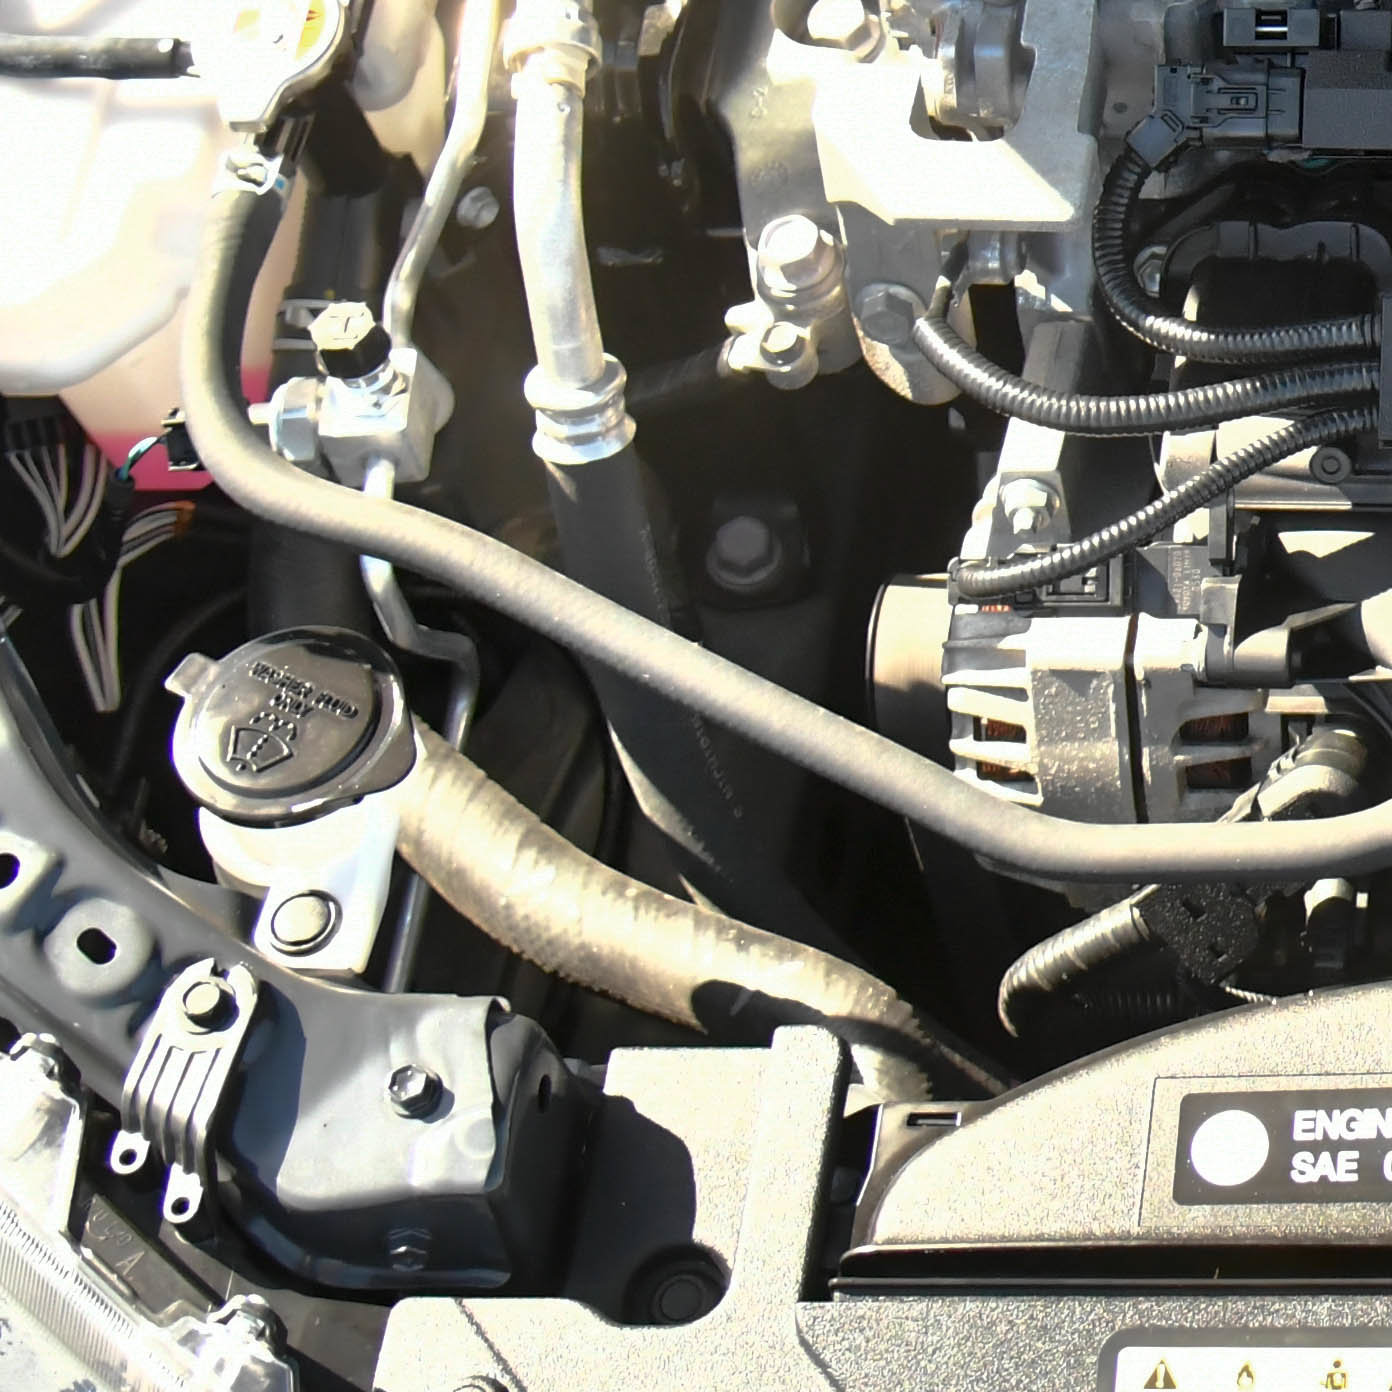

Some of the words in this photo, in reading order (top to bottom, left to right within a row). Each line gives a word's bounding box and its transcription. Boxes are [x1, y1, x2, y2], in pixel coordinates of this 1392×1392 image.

[248, 661, 314, 699] WASHER
[312, 691, 359, 720] FLUID
[1289, 1149, 1361, 1184] SAE
